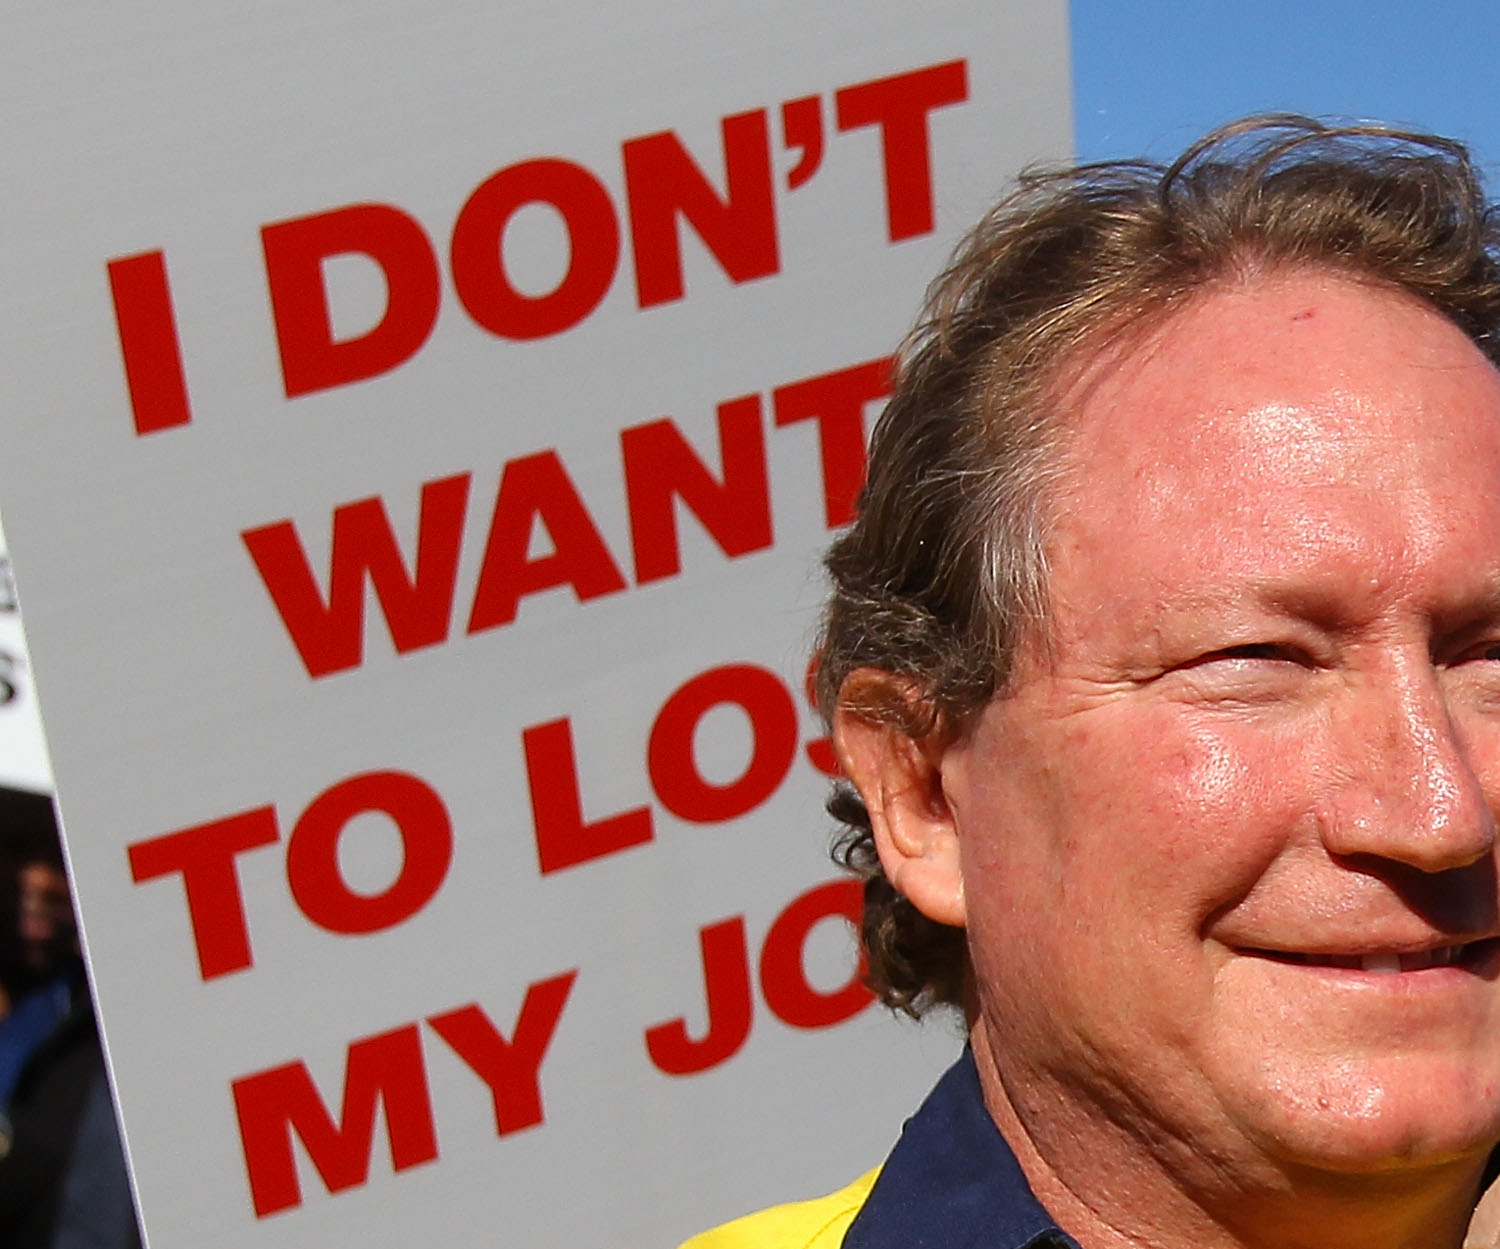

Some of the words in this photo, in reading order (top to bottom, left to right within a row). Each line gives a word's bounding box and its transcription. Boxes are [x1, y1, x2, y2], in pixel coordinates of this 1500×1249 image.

[107, 249, 191, 436] I
[260, 58, 969, 399] DON'T
[241, 356, 896, 680] WANT
[127, 768, 454, 982] TO
[231, 970, 578, 1220] MY
